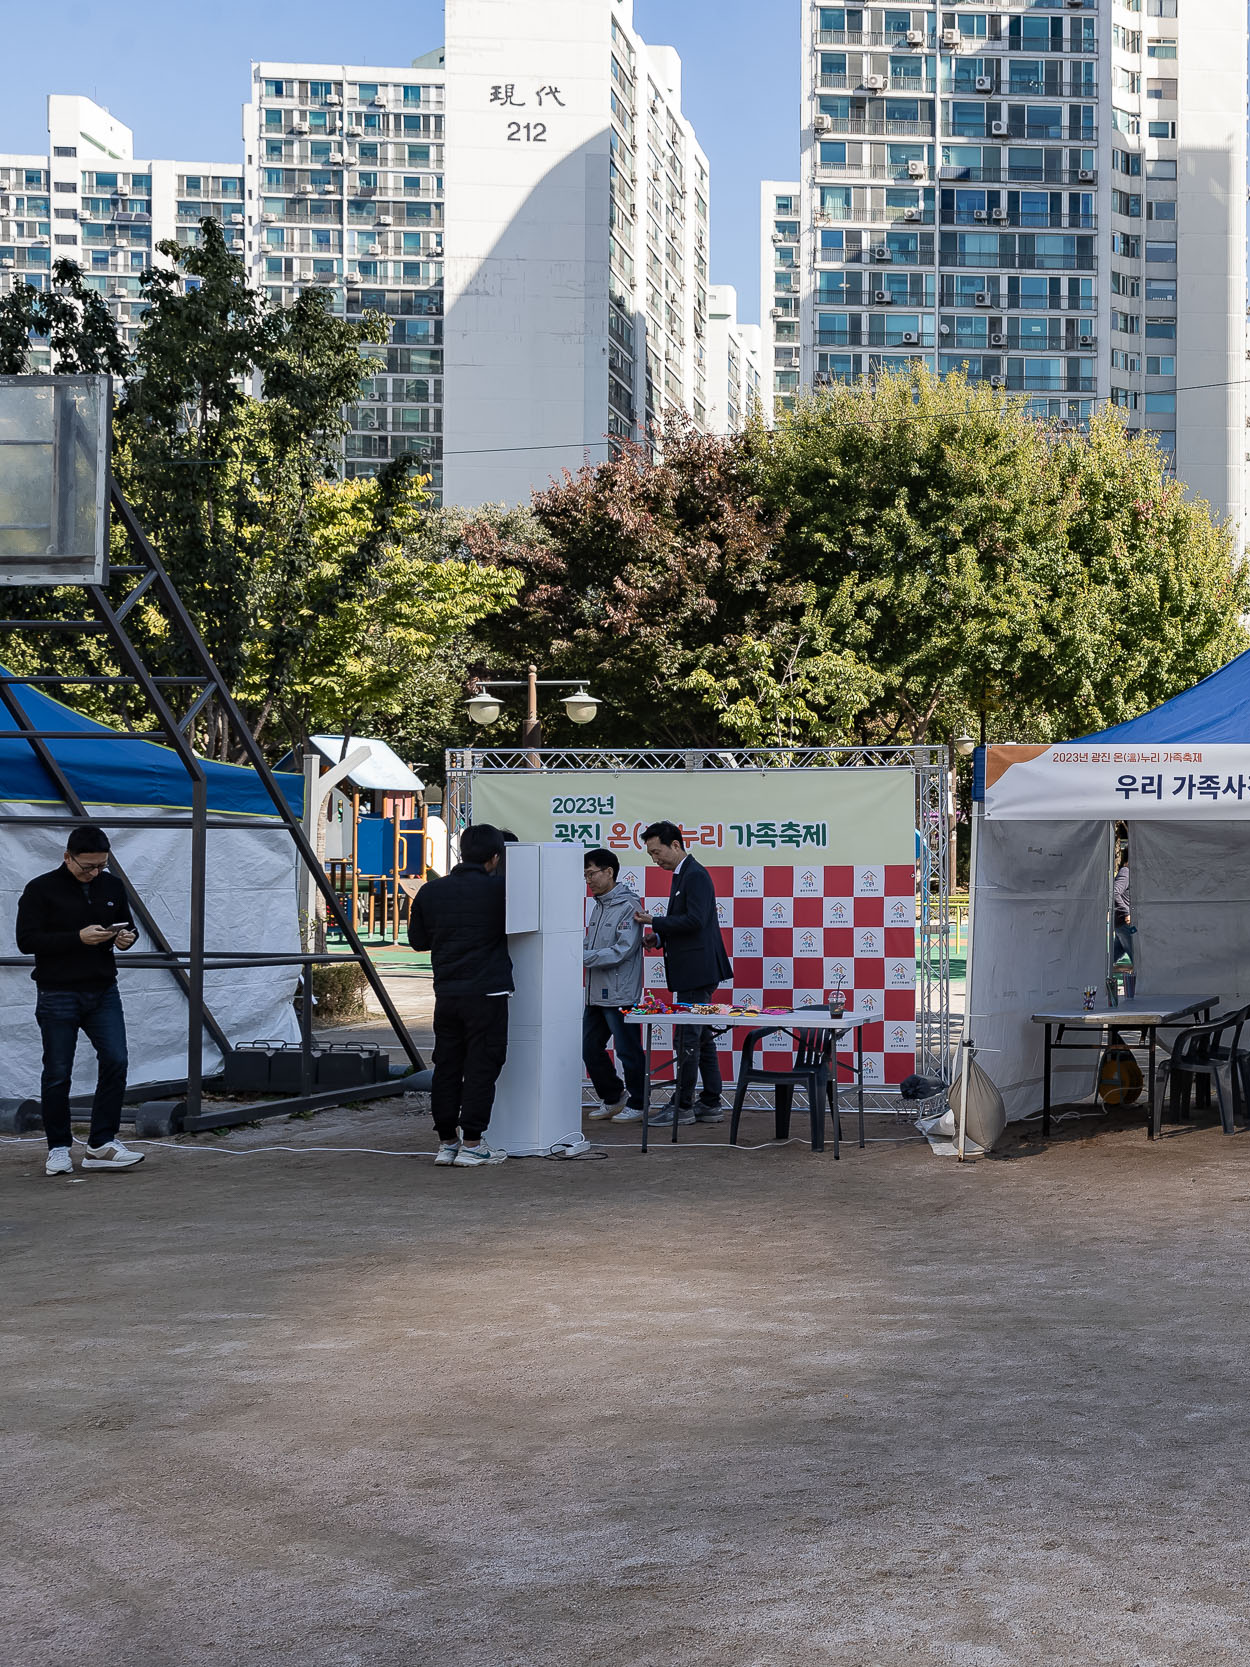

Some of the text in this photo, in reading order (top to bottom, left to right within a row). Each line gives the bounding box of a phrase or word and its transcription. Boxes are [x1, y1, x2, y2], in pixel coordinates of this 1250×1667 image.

[490, 84, 566, 106] 現代
[507, 121, 547, 142] 212
[1052, 752, 1089, 763] 2023년
[1091, 752, 1111, 763] 광진
[1163, 752, 1202, 763] 가족축제
[1115, 774, 1163, 800] 우리
[552, 796, 614, 815] 2023년
[555, 823, 601, 848] 광진
[729, 821, 827, 848] 가족축제
